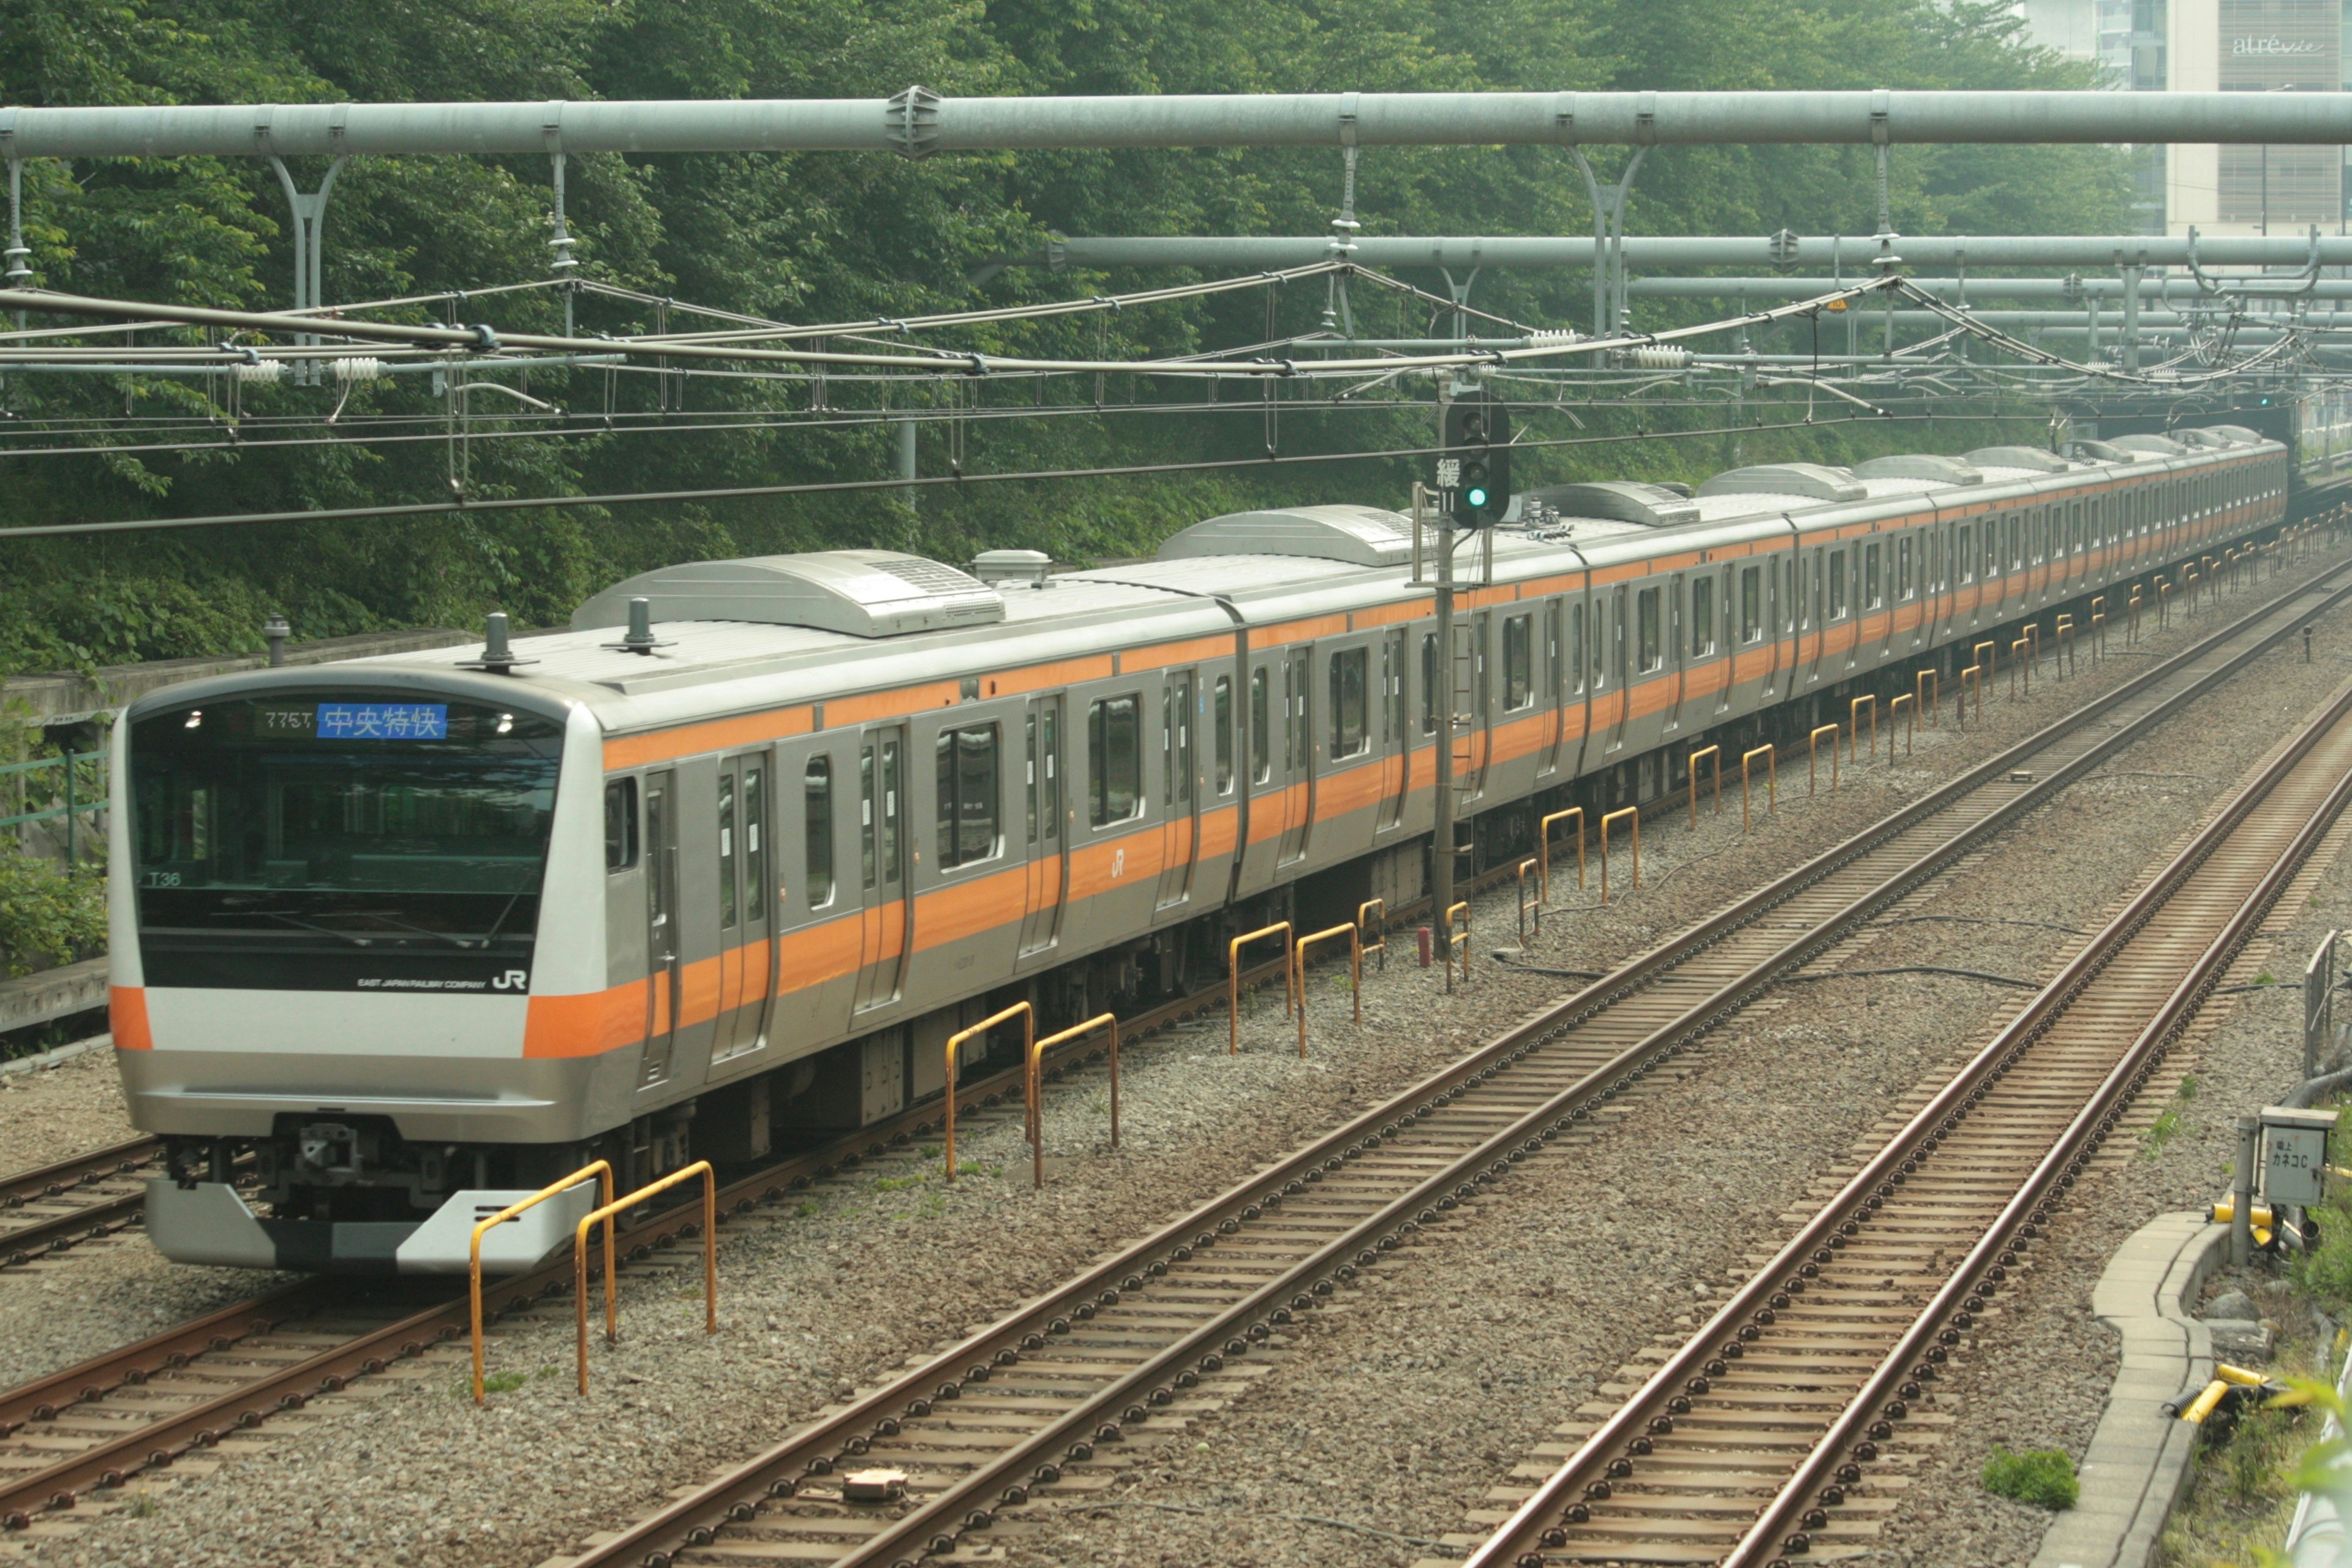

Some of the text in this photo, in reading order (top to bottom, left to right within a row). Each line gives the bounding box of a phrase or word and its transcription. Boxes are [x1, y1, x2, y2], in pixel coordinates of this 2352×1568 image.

[1436, 458, 1460, 488] 緩
[325, 707, 440, 736] 中央特快
[1112, 849, 1124, 878] JR
[149, 872, 181, 886] T36
[357, 979, 486, 989] EAST JAPAN RAILWAY COMPANY
[492, 970, 527, 990] JR
